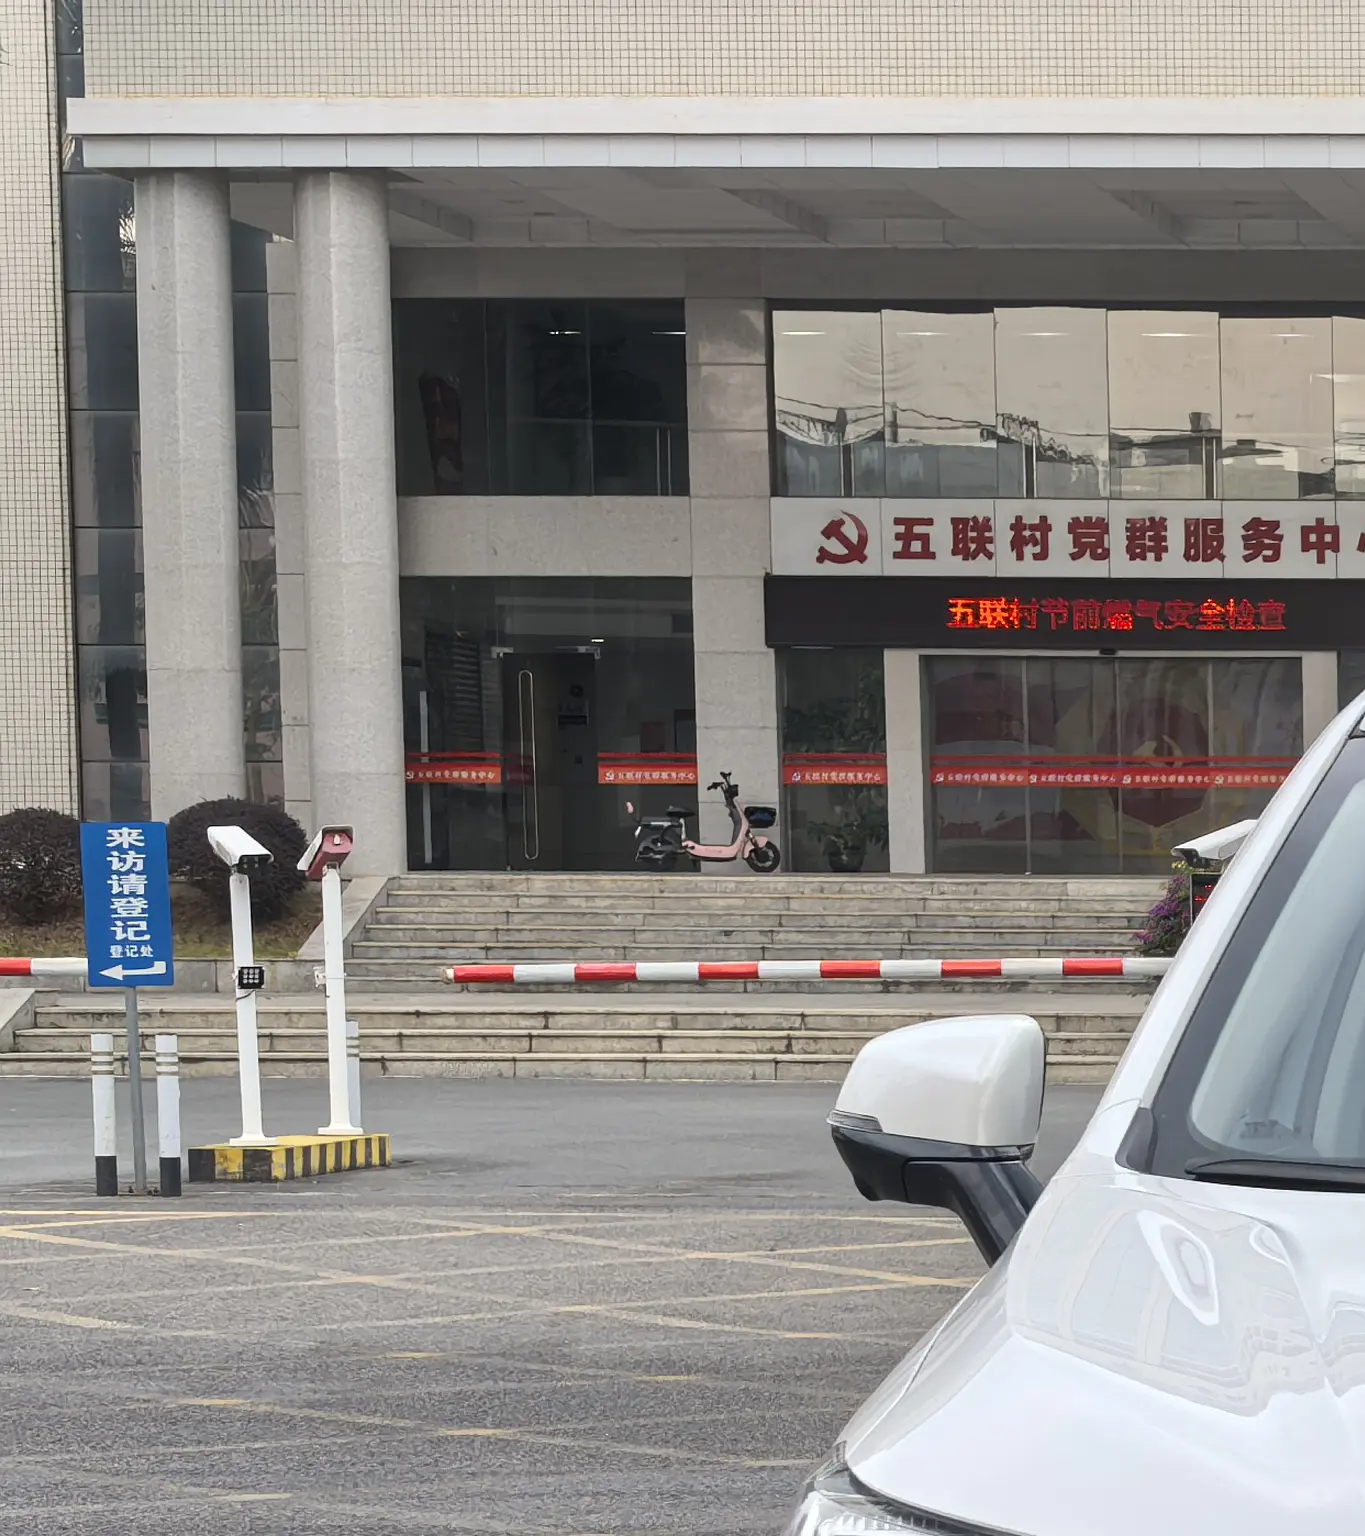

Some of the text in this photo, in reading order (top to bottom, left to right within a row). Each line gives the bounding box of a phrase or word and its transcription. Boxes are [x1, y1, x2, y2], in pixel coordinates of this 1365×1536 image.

[947, 598, 1286, 631] 五联村节前燃气安全检查
[106, 827, 151, 941] 来访请登记
[109, 945, 154, 958] 登记处
